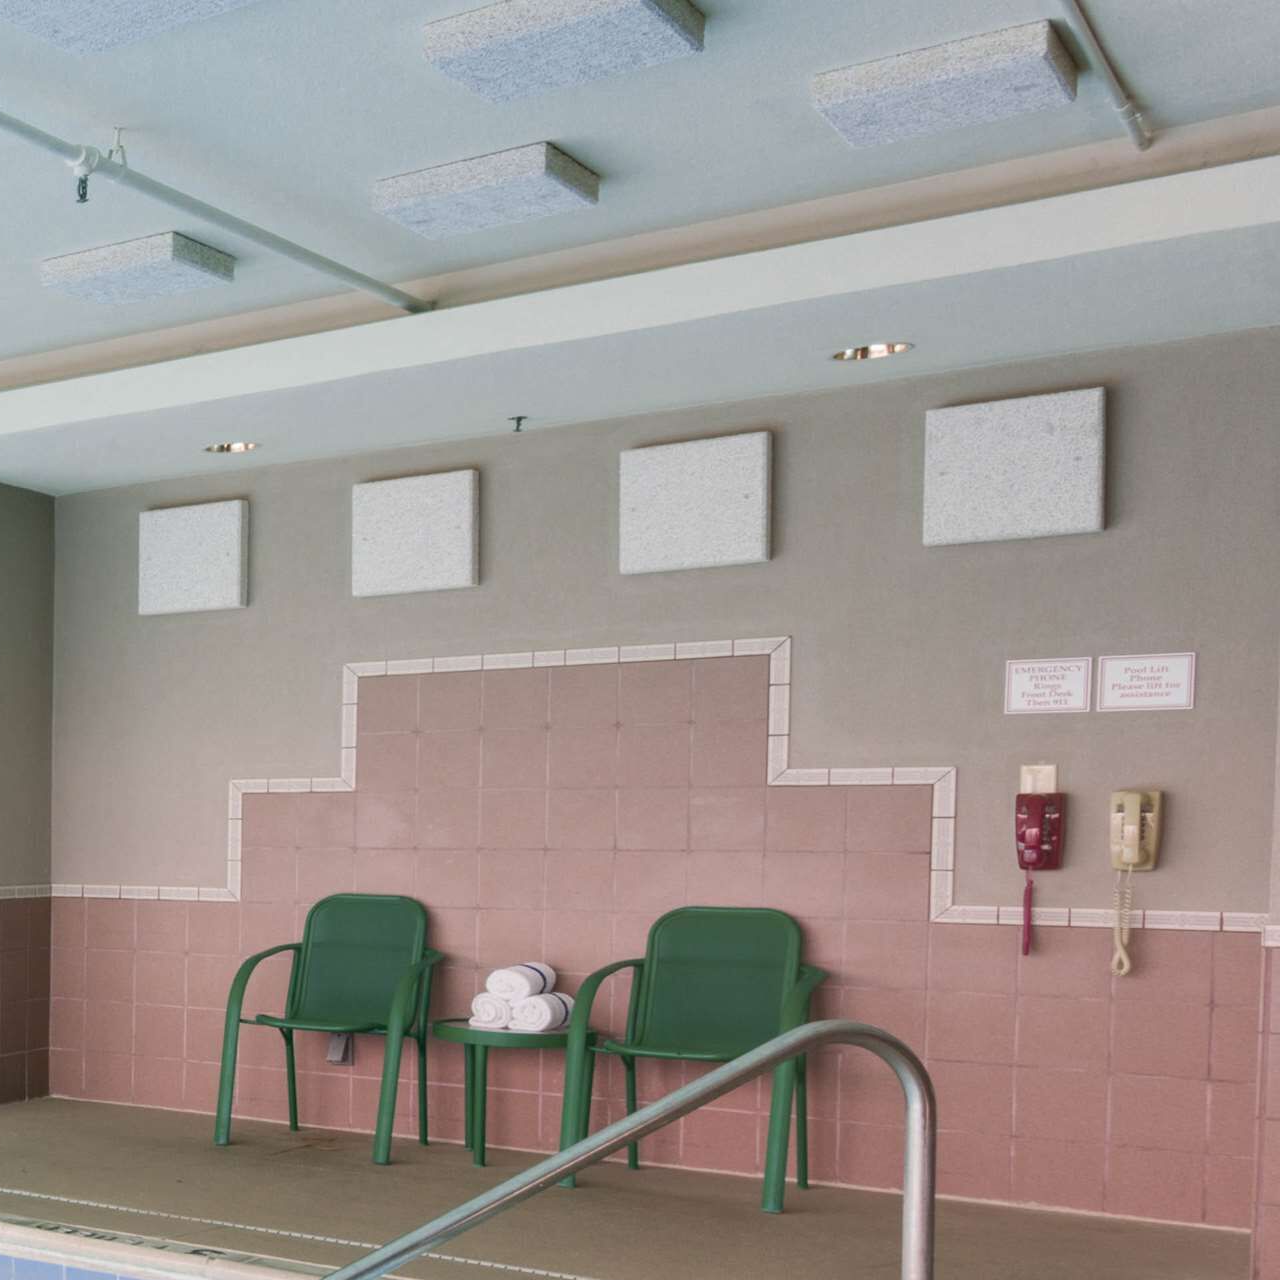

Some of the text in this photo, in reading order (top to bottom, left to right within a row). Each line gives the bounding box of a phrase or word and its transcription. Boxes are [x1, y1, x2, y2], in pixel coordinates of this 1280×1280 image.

[1014, 665, 1082, 673] EMERGENCY
[1124, 666, 1147, 674] Pool
[1130, 674, 1162, 682] Phone
